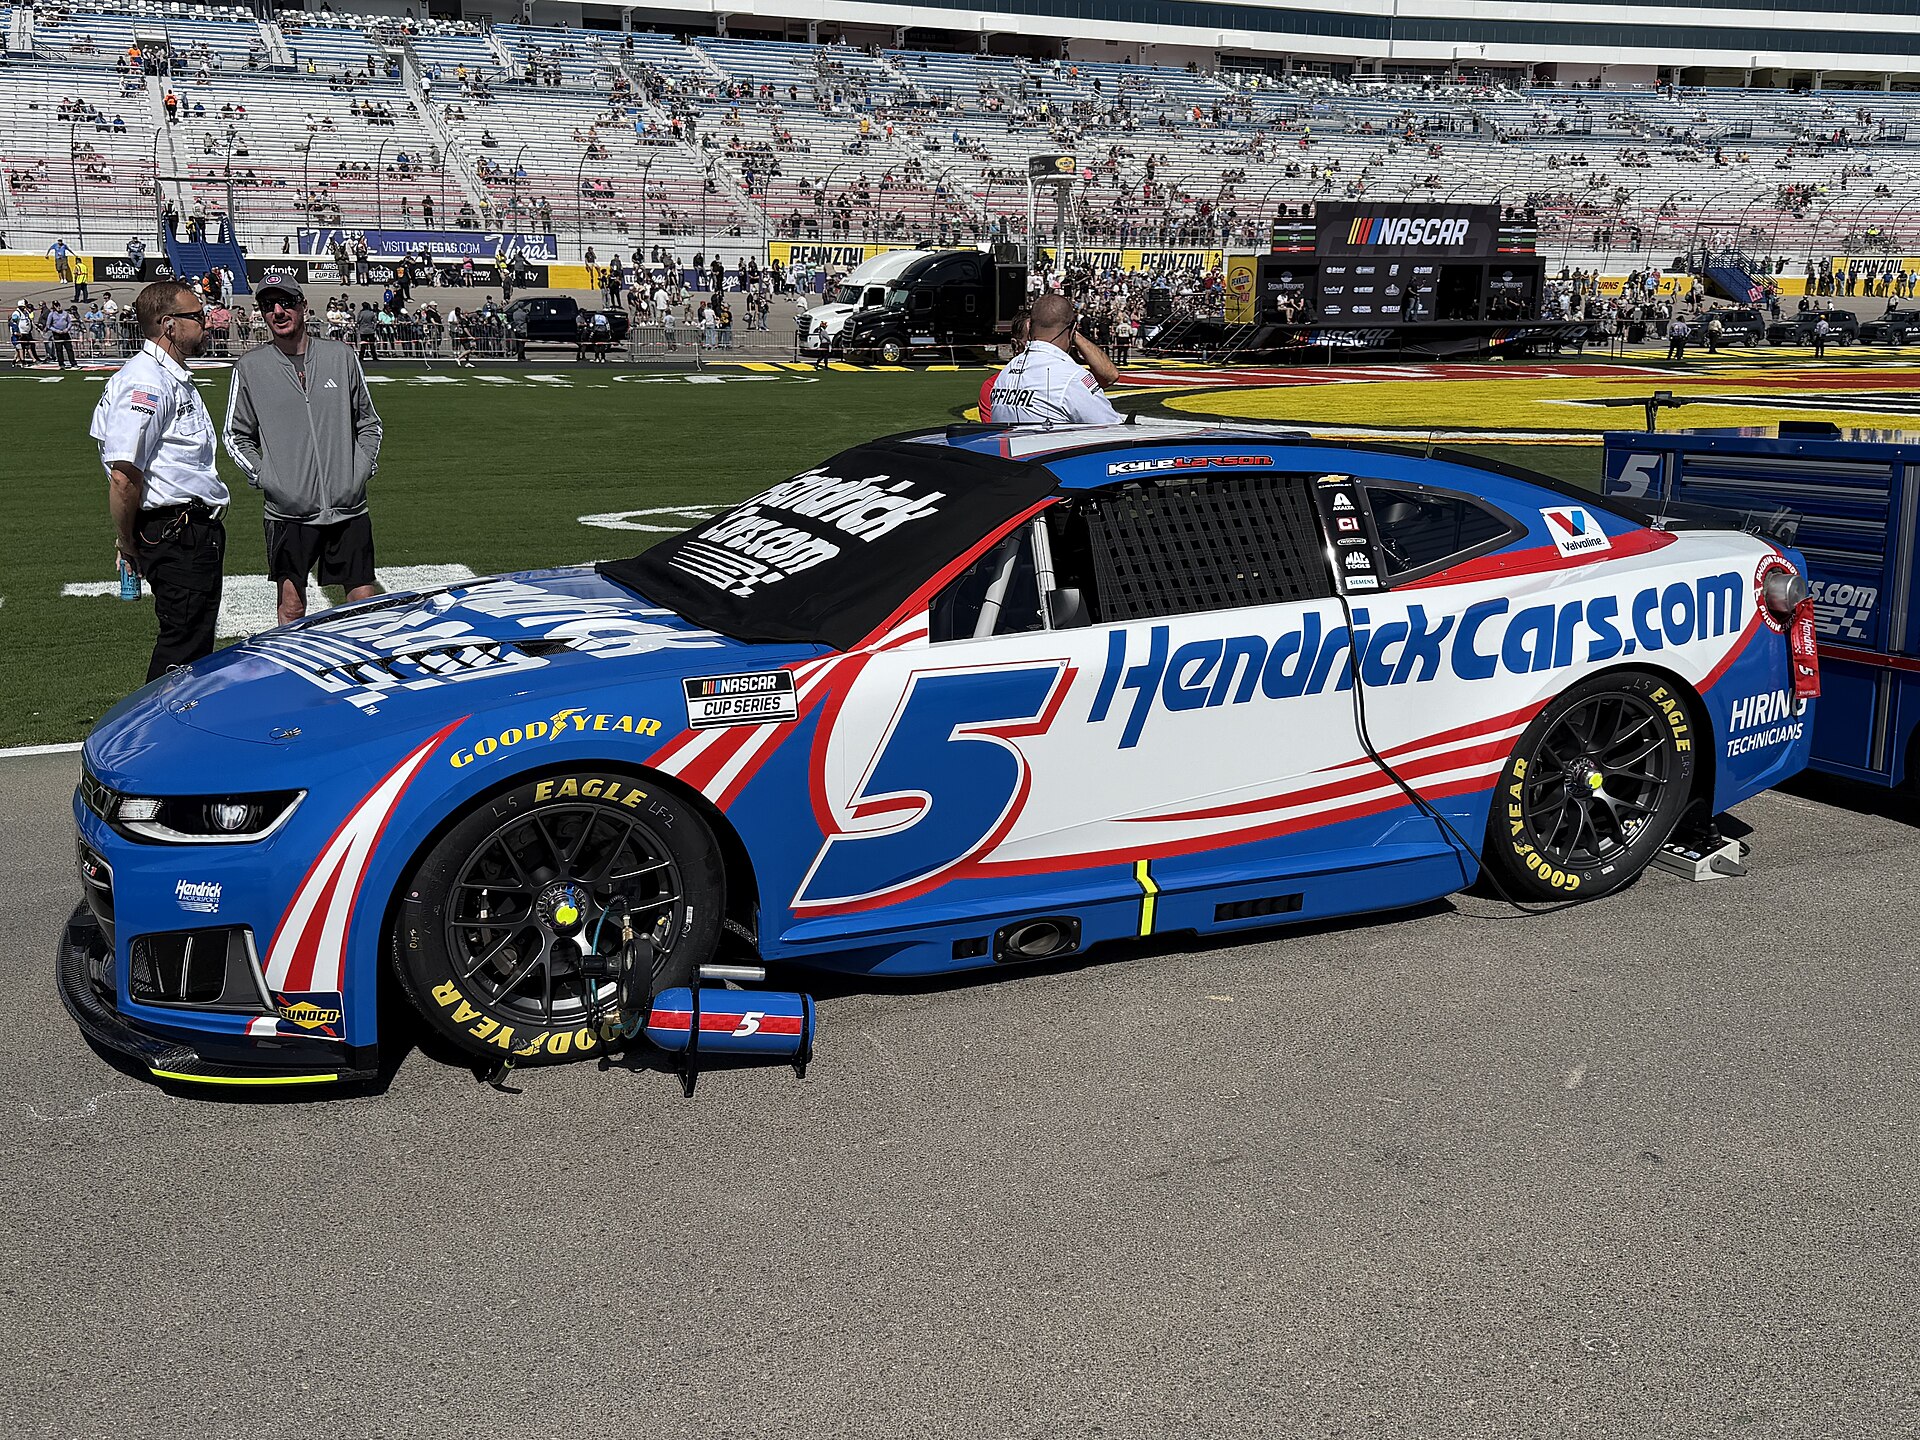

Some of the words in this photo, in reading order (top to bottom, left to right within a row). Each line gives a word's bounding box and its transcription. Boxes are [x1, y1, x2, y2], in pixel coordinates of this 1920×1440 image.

[1377, 218, 1468, 245] NASCAR
[382, 241, 480, 254] VISITLASVEGAS.COM
[790, 246, 864, 265] PENNZOIL
[263, 265, 299, 277] xfinity
[1140, 252, 1205, 271] PENNZOIL
[1850, 259, 1903, 274] PENNZOIL
[106, 267, 135, 276] BUSCH
[369, 271, 394, 279] BUSCH
[509, 270, 538, 281] xfity
[1598, 281, 1620, 290] URNS
[990, 388, 1035, 407] OFFICIAL
[1562, 537, 1603, 551] Valvoline
[1800, 618, 1816, 656] Hendrick
[1087, 571, 1744, 749] HendrickCars.com
[721, 676, 777, 693] NASCAR
[704, 701, 731, 716] CUP
[733, 697, 781, 713] SERIES
[1729, 688, 1807, 733] HIRING
[1649, 687, 1691, 752] EAGLE
[1727, 723, 1803, 758] TECHNICIANS
[534, 778, 648, 809] EAGLE
[789, 658, 1074, 912] 5
[175, 879, 222, 899] Hendrick
[280, 1007, 338, 1022] SUNOCO
[731, 1011, 766, 1037] 5
